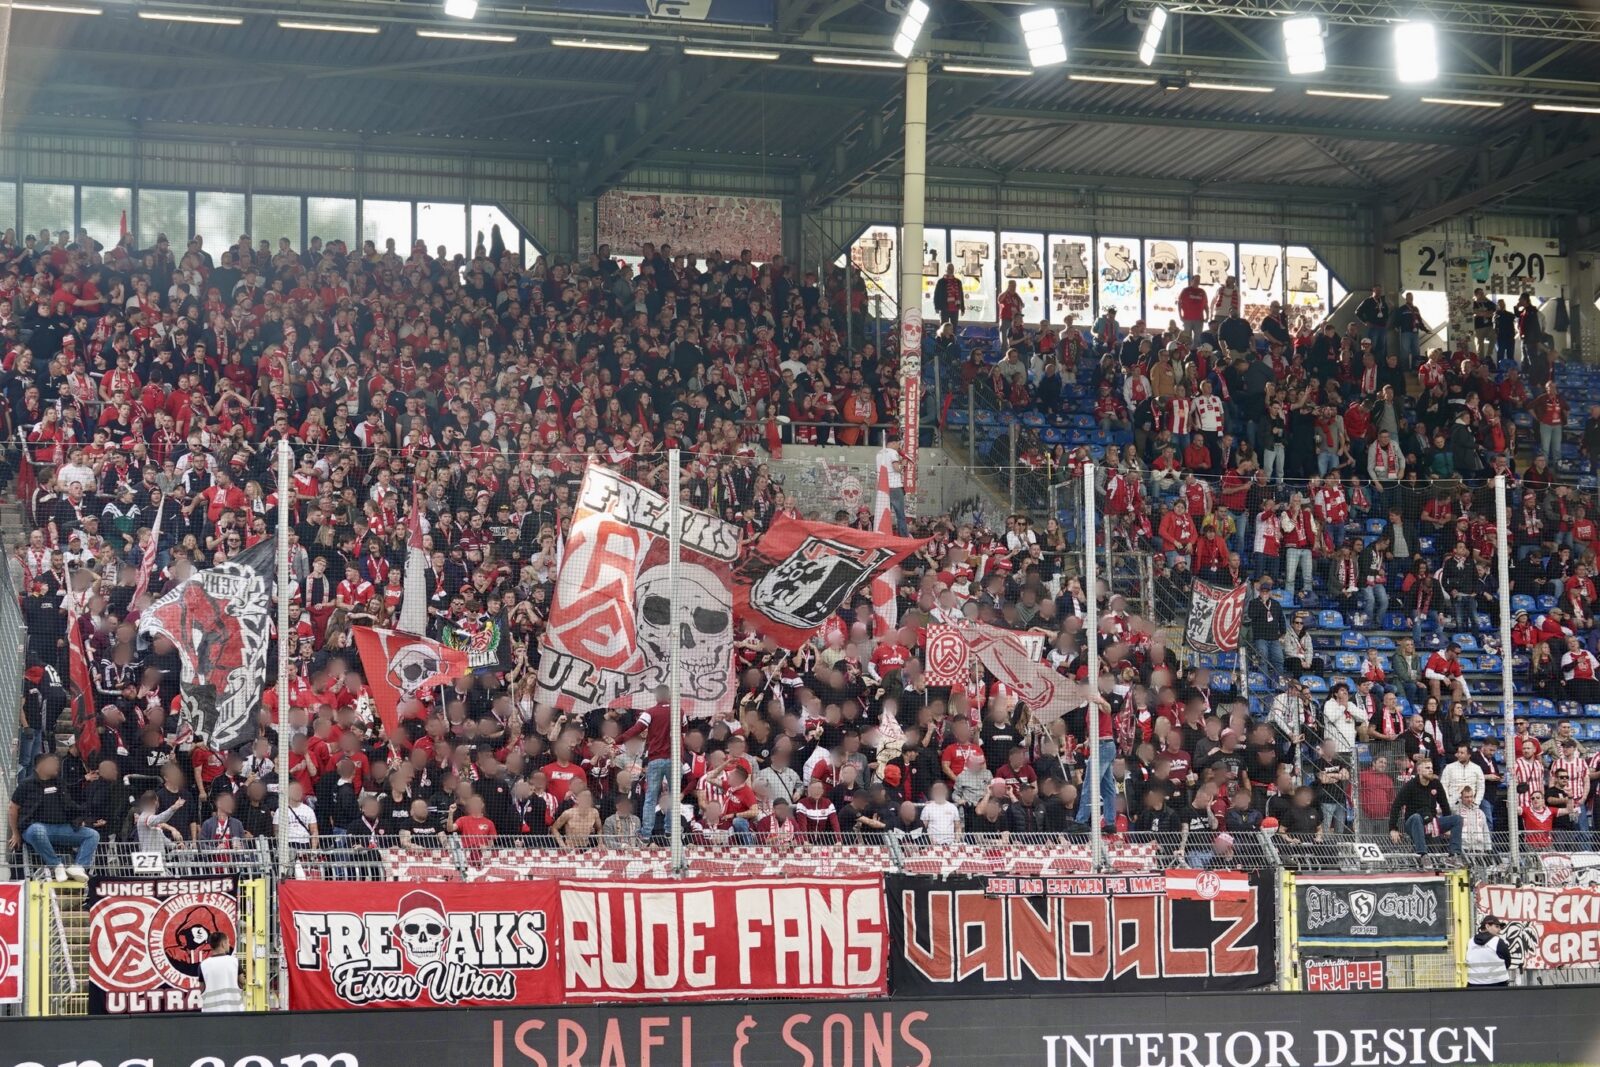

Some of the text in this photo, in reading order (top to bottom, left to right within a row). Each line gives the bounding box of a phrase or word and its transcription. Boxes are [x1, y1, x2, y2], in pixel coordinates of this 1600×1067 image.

[1195, 251, 1317, 292] RWE
[1509, 252, 1545, 283] 20
[909, 383, 917, 425] JUNGE
[582, 473, 743, 562] FREAKS
[136, 855, 158, 868] 27
[1358, 842, 1380, 859] 26
[96, 879, 233, 897] JUNGE ESSENER
[986, 878, 1016, 894] JOSH
[1129, 877, 1166, 893] IMMER
[1377, 884, 1437, 926] Garde
[294, 911, 548, 970] FREAKS
[560, 888, 883, 990] RUDE FANS
[1542, 930, 1600, 963] CRE
[333, 960, 516, 1004] Essen Ultras
[1307, 961, 1383, 991] GRUPPE
[106, 989, 205, 1014] ULTRA
[782, 1010, 931, 1067] SONS
[1042, 1026, 1497, 1067] INTERIOR DESIGN
